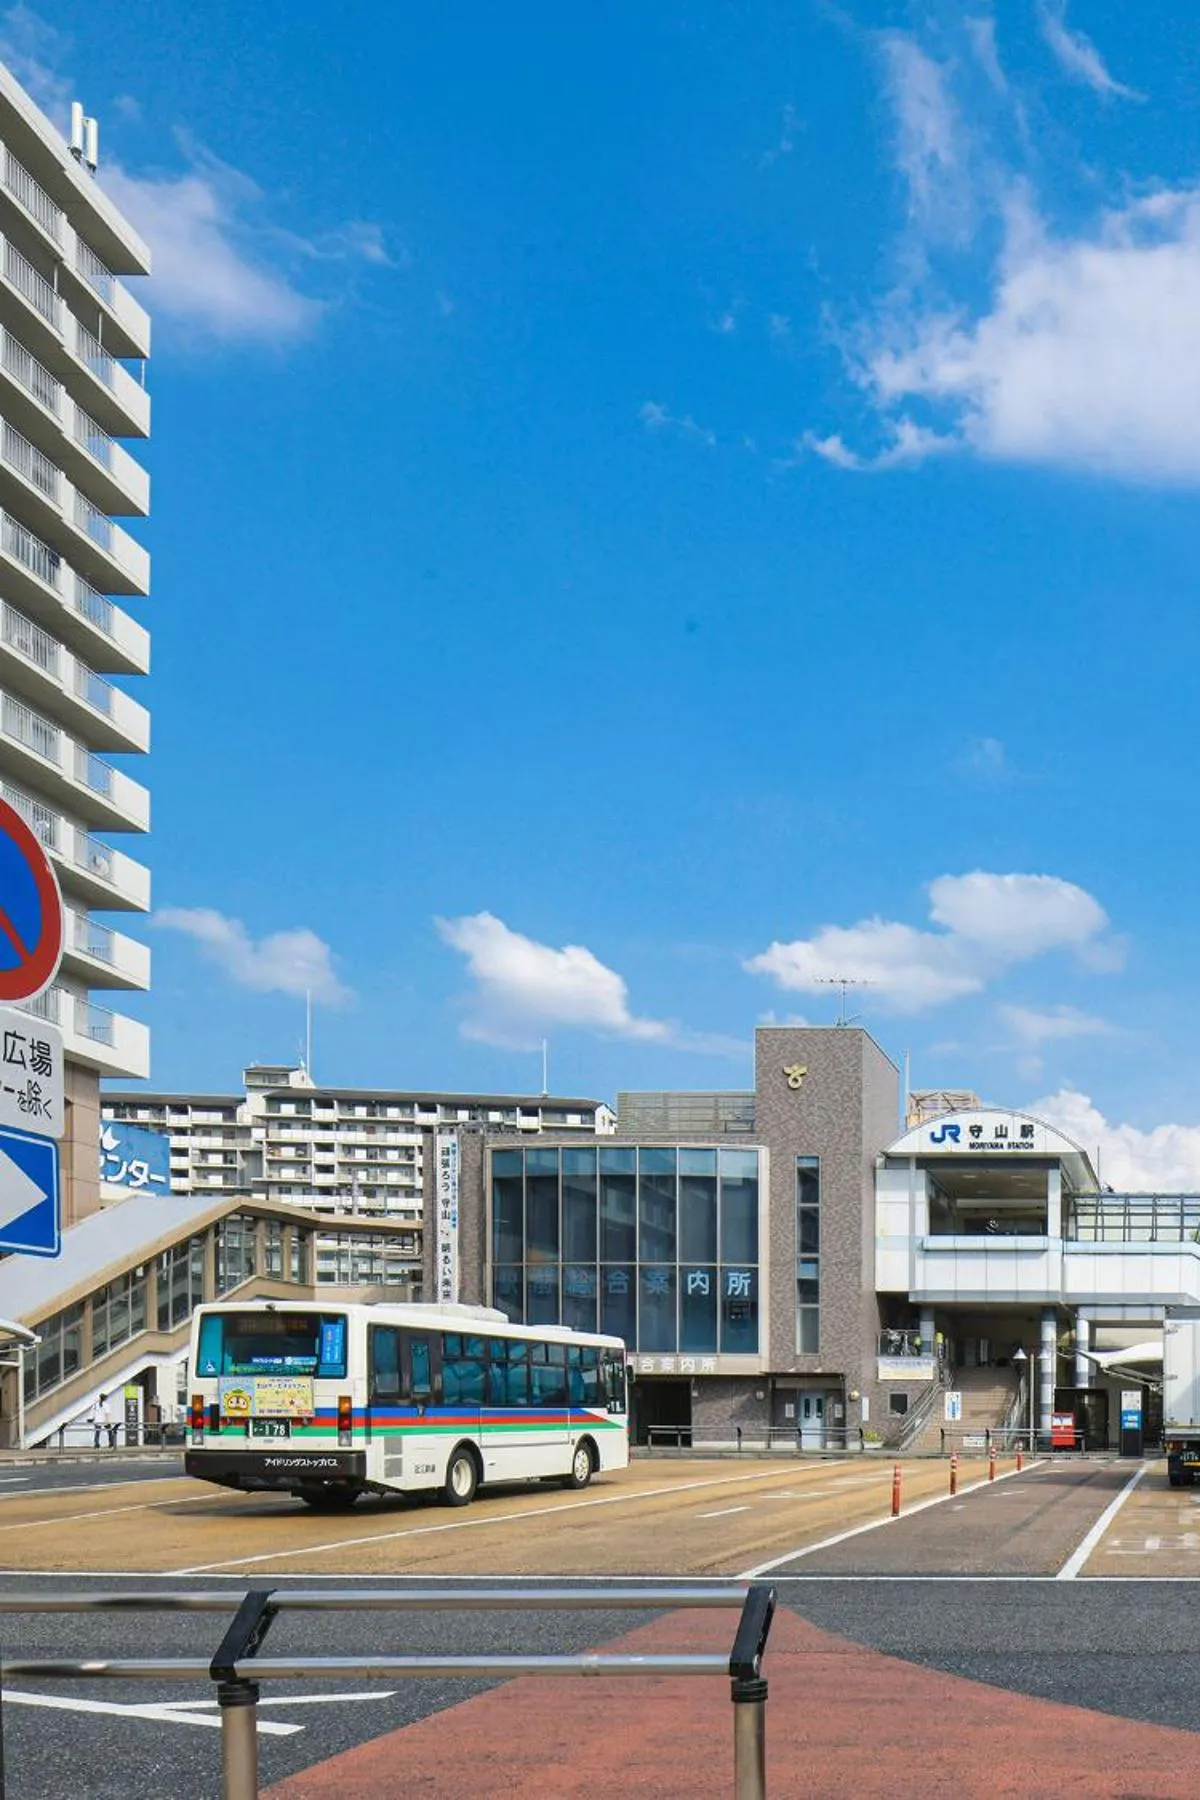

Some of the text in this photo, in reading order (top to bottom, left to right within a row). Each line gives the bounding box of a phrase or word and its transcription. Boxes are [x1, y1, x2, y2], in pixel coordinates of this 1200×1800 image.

[3, 1030, 52, 1077] 広場
[0, 1079, 52, 1120] ーを除く
[930, 1125, 960, 1143] JR
[969, 1124, 1034, 1139] 守山駅
